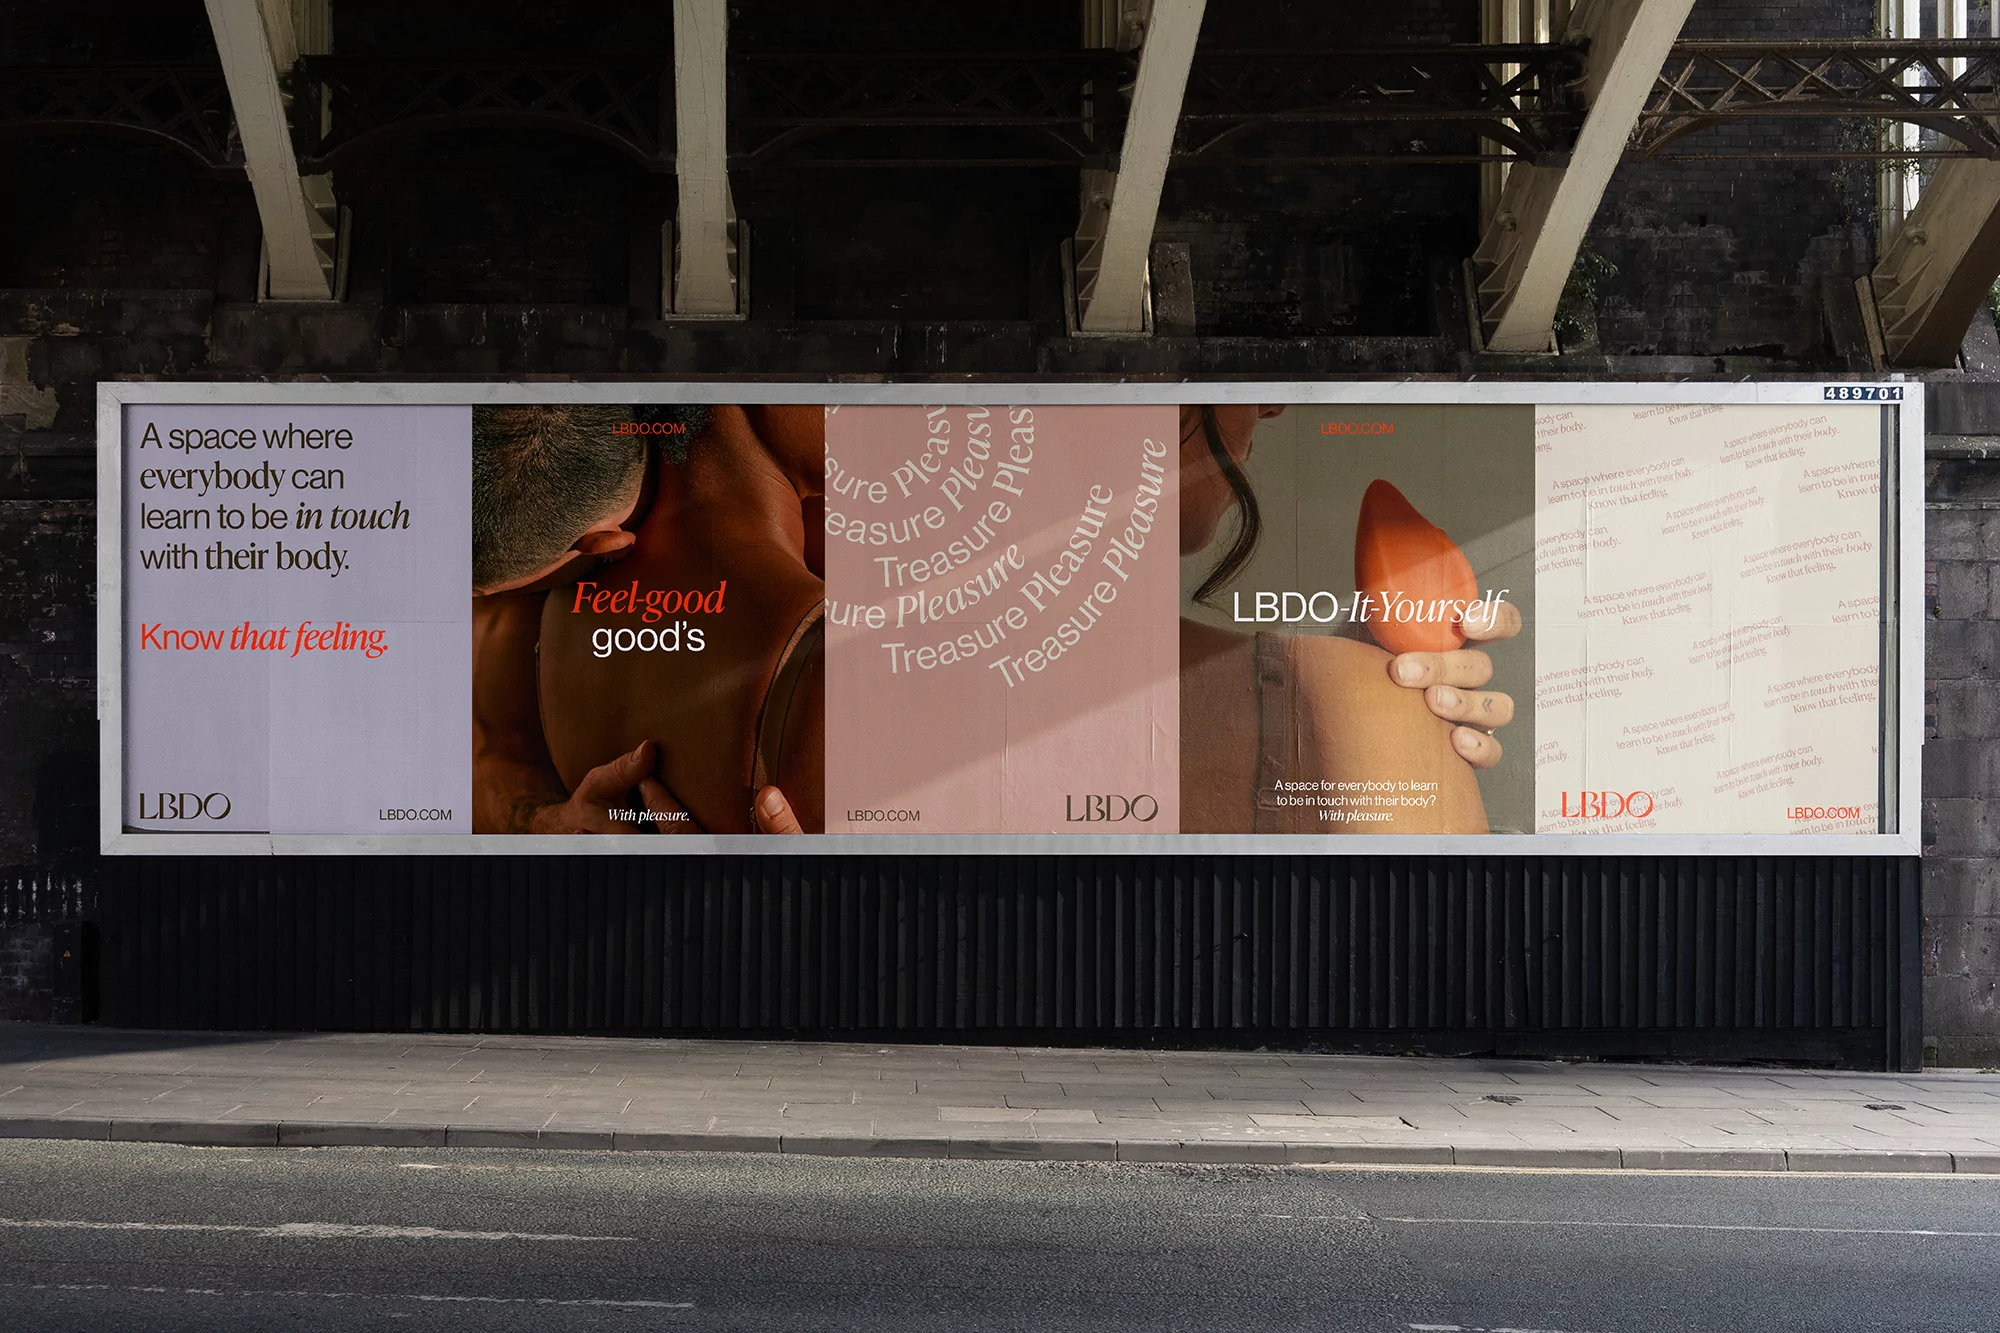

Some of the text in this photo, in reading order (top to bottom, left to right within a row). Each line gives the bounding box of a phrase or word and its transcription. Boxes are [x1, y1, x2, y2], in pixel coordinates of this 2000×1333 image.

[1826, 388, 1901, 400] 489701
[140, 423, 354, 454] A space where
[612, 423, 685, 435] LBDO.COM
[1321, 422, 1394, 435] LBDO.COM
[140, 461, 345, 497] everybody can
[1561, 477, 1590, 489] space
[1591, 471, 1624, 482] where
[1626, 461, 1670, 476] everybody
[1671, 457, 1685, 467] can
[1804, 460, 1875, 478] A space where
[874, 405, 1035, 588] Treasure Pleas
[1548, 493, 1570, 505] learn
[1610, 481, 1636, 493] touch
[1637, 478, 1656, 488] with
[1656, 474, 1674, 485] their
[1799, 482, 1821, 494] learn
[1822, 480, 1832, 488] to
[1833, 478, 1847, 486] be
[1848, 475, 1858, 484] in
[1838, 488, 1867, 499] Know
[141, 500, 411, 530] learn to be in touch
[1588, 499, 1617, 510] Know
[1620, 494, 1639, 505] that
[825, 506, 946, 545] easure
[140, 541, 350, 578] with their body.
[989, 438, 1167, 688] Treasure Pleasure
[882, 484, 1113, 674] Treasure Pleasure
[896, 544, 1025, 629] Pleasure
[571, 580, 728, 623] Feel-good
[1234, 589, 1509, 632] LBDO-It-Yourself
[141, 621, 389, 659] Know that feeling.
[592, 621, 706, 659] good's
[1544, 657, 1645, 681] where everybody can
[1557, 679, 1582, 692] touch
[1583, 676, 1606, 687] with
[1607, 672, 1630, 683] their
[1774, 681, 1796, 692] space
[1796, 675, 1824, 686] where
[1825, 665, 1878, 680] everybody
[1540, 701, 1563, 710] Know
[1565, 694, 1584, 704] that
[1764, 698, 1782, 709] learn
[1810, 684, 1836, 697] touch
[1836, 680, 1860, 691] with
[1793, 704, 1817, 714] Know
[1819, 699, 1838, 708] that
[1275, 780, 1438, 793] A space for everybody to learn
[140, 793, 232, 820] LBDO
[379, 809, 452, 821] LBDO.COM
[1066, 794, 1159, 822] LBDO
[1277, 795, 1437, 809] to be in touch with their body?
[1562, 791, 1654, 818] LBDO
[1787, 807, 1861, 819] LBDO.COM
[608, 809, 690, 824] With pleasure.
[847, 810, 921, 822] LBDO.COM
[1319, 810, 1394, 824] With pleasure.
